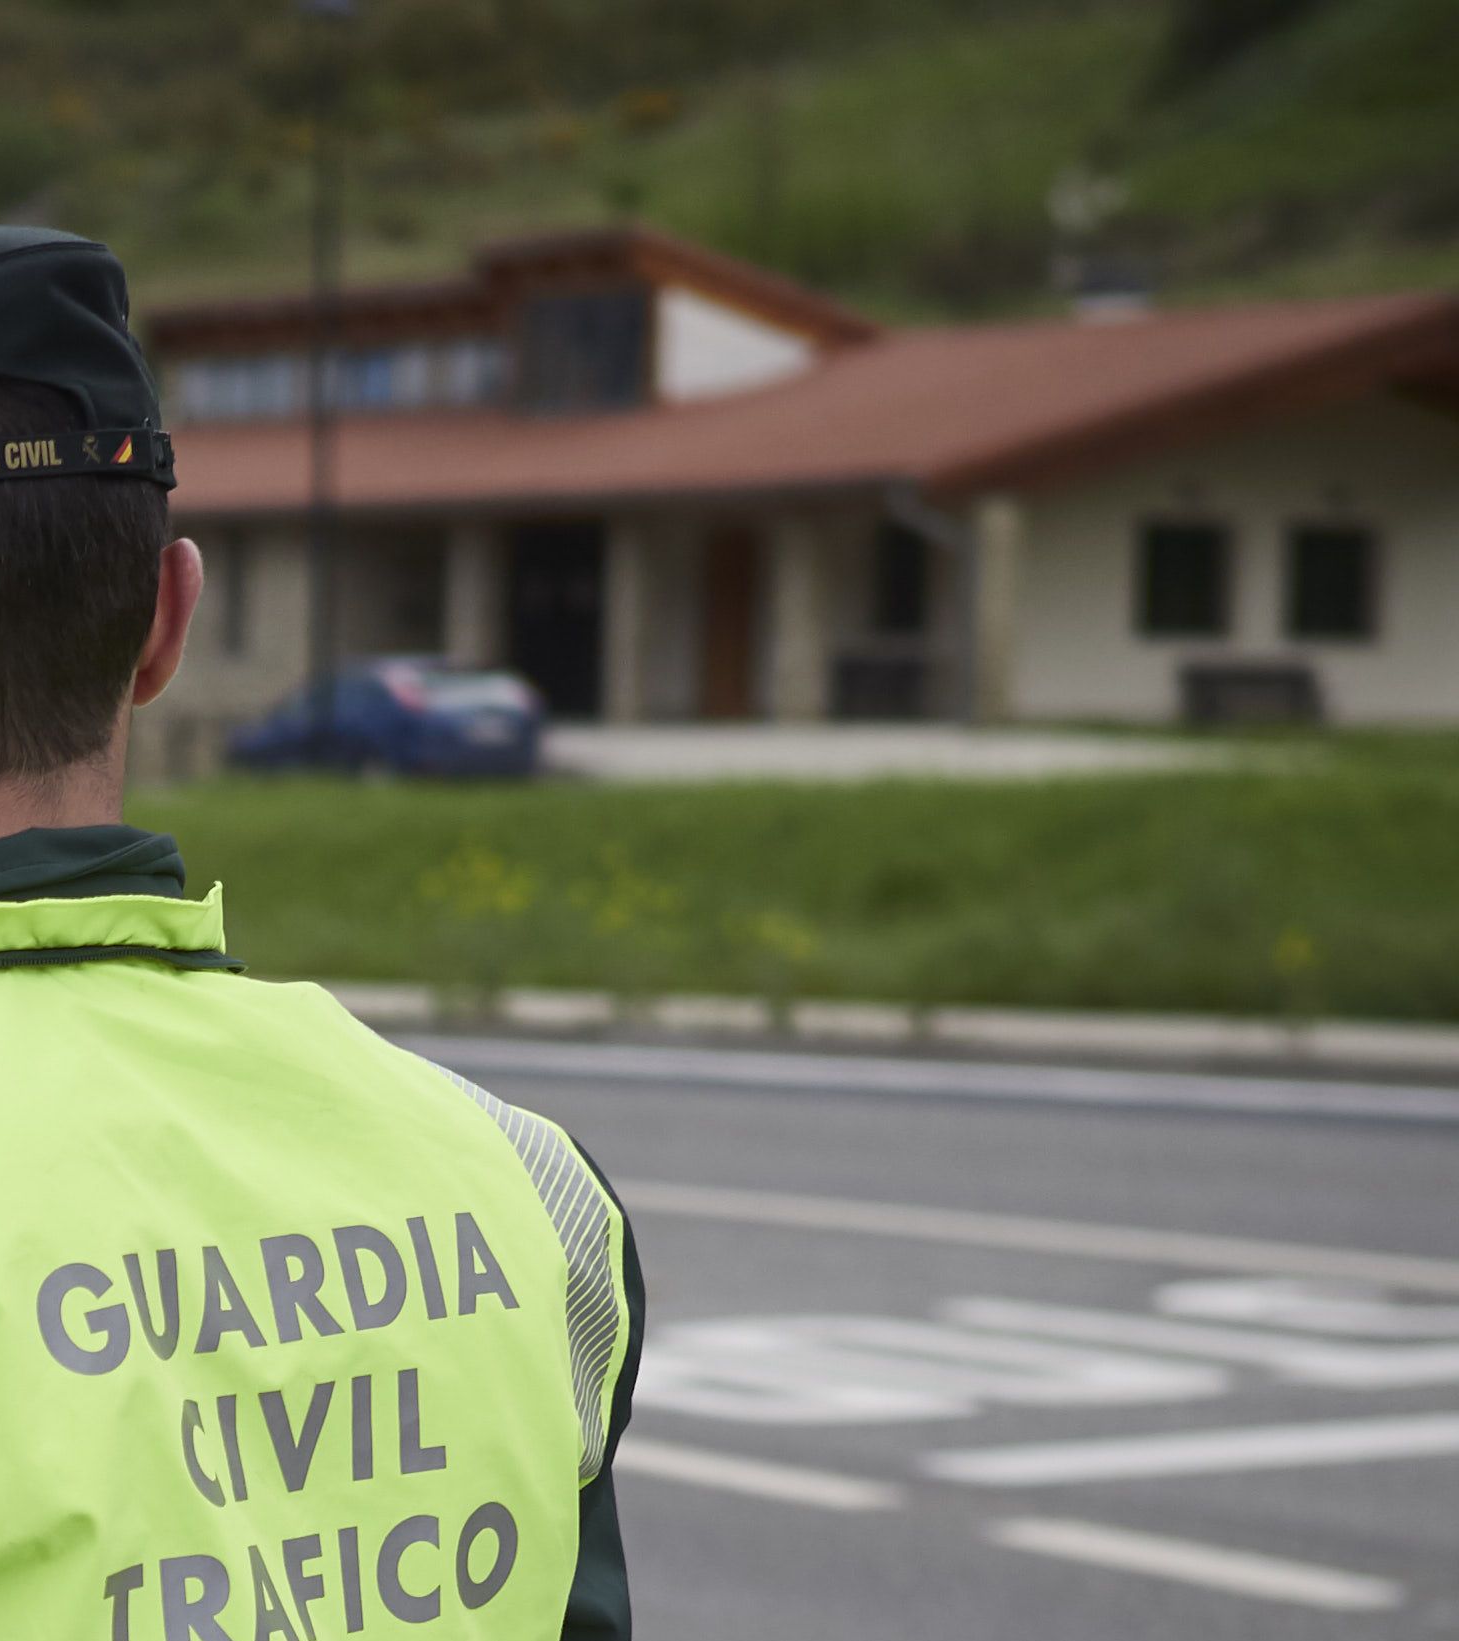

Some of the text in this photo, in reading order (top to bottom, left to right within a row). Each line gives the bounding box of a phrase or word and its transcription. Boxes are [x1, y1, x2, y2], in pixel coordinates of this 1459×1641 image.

[3, 439, 63, 471] CIVIL
[35, 1211, 521, 1376] GUARDIA
[180, 1367, 447, 1508] CIVIL
